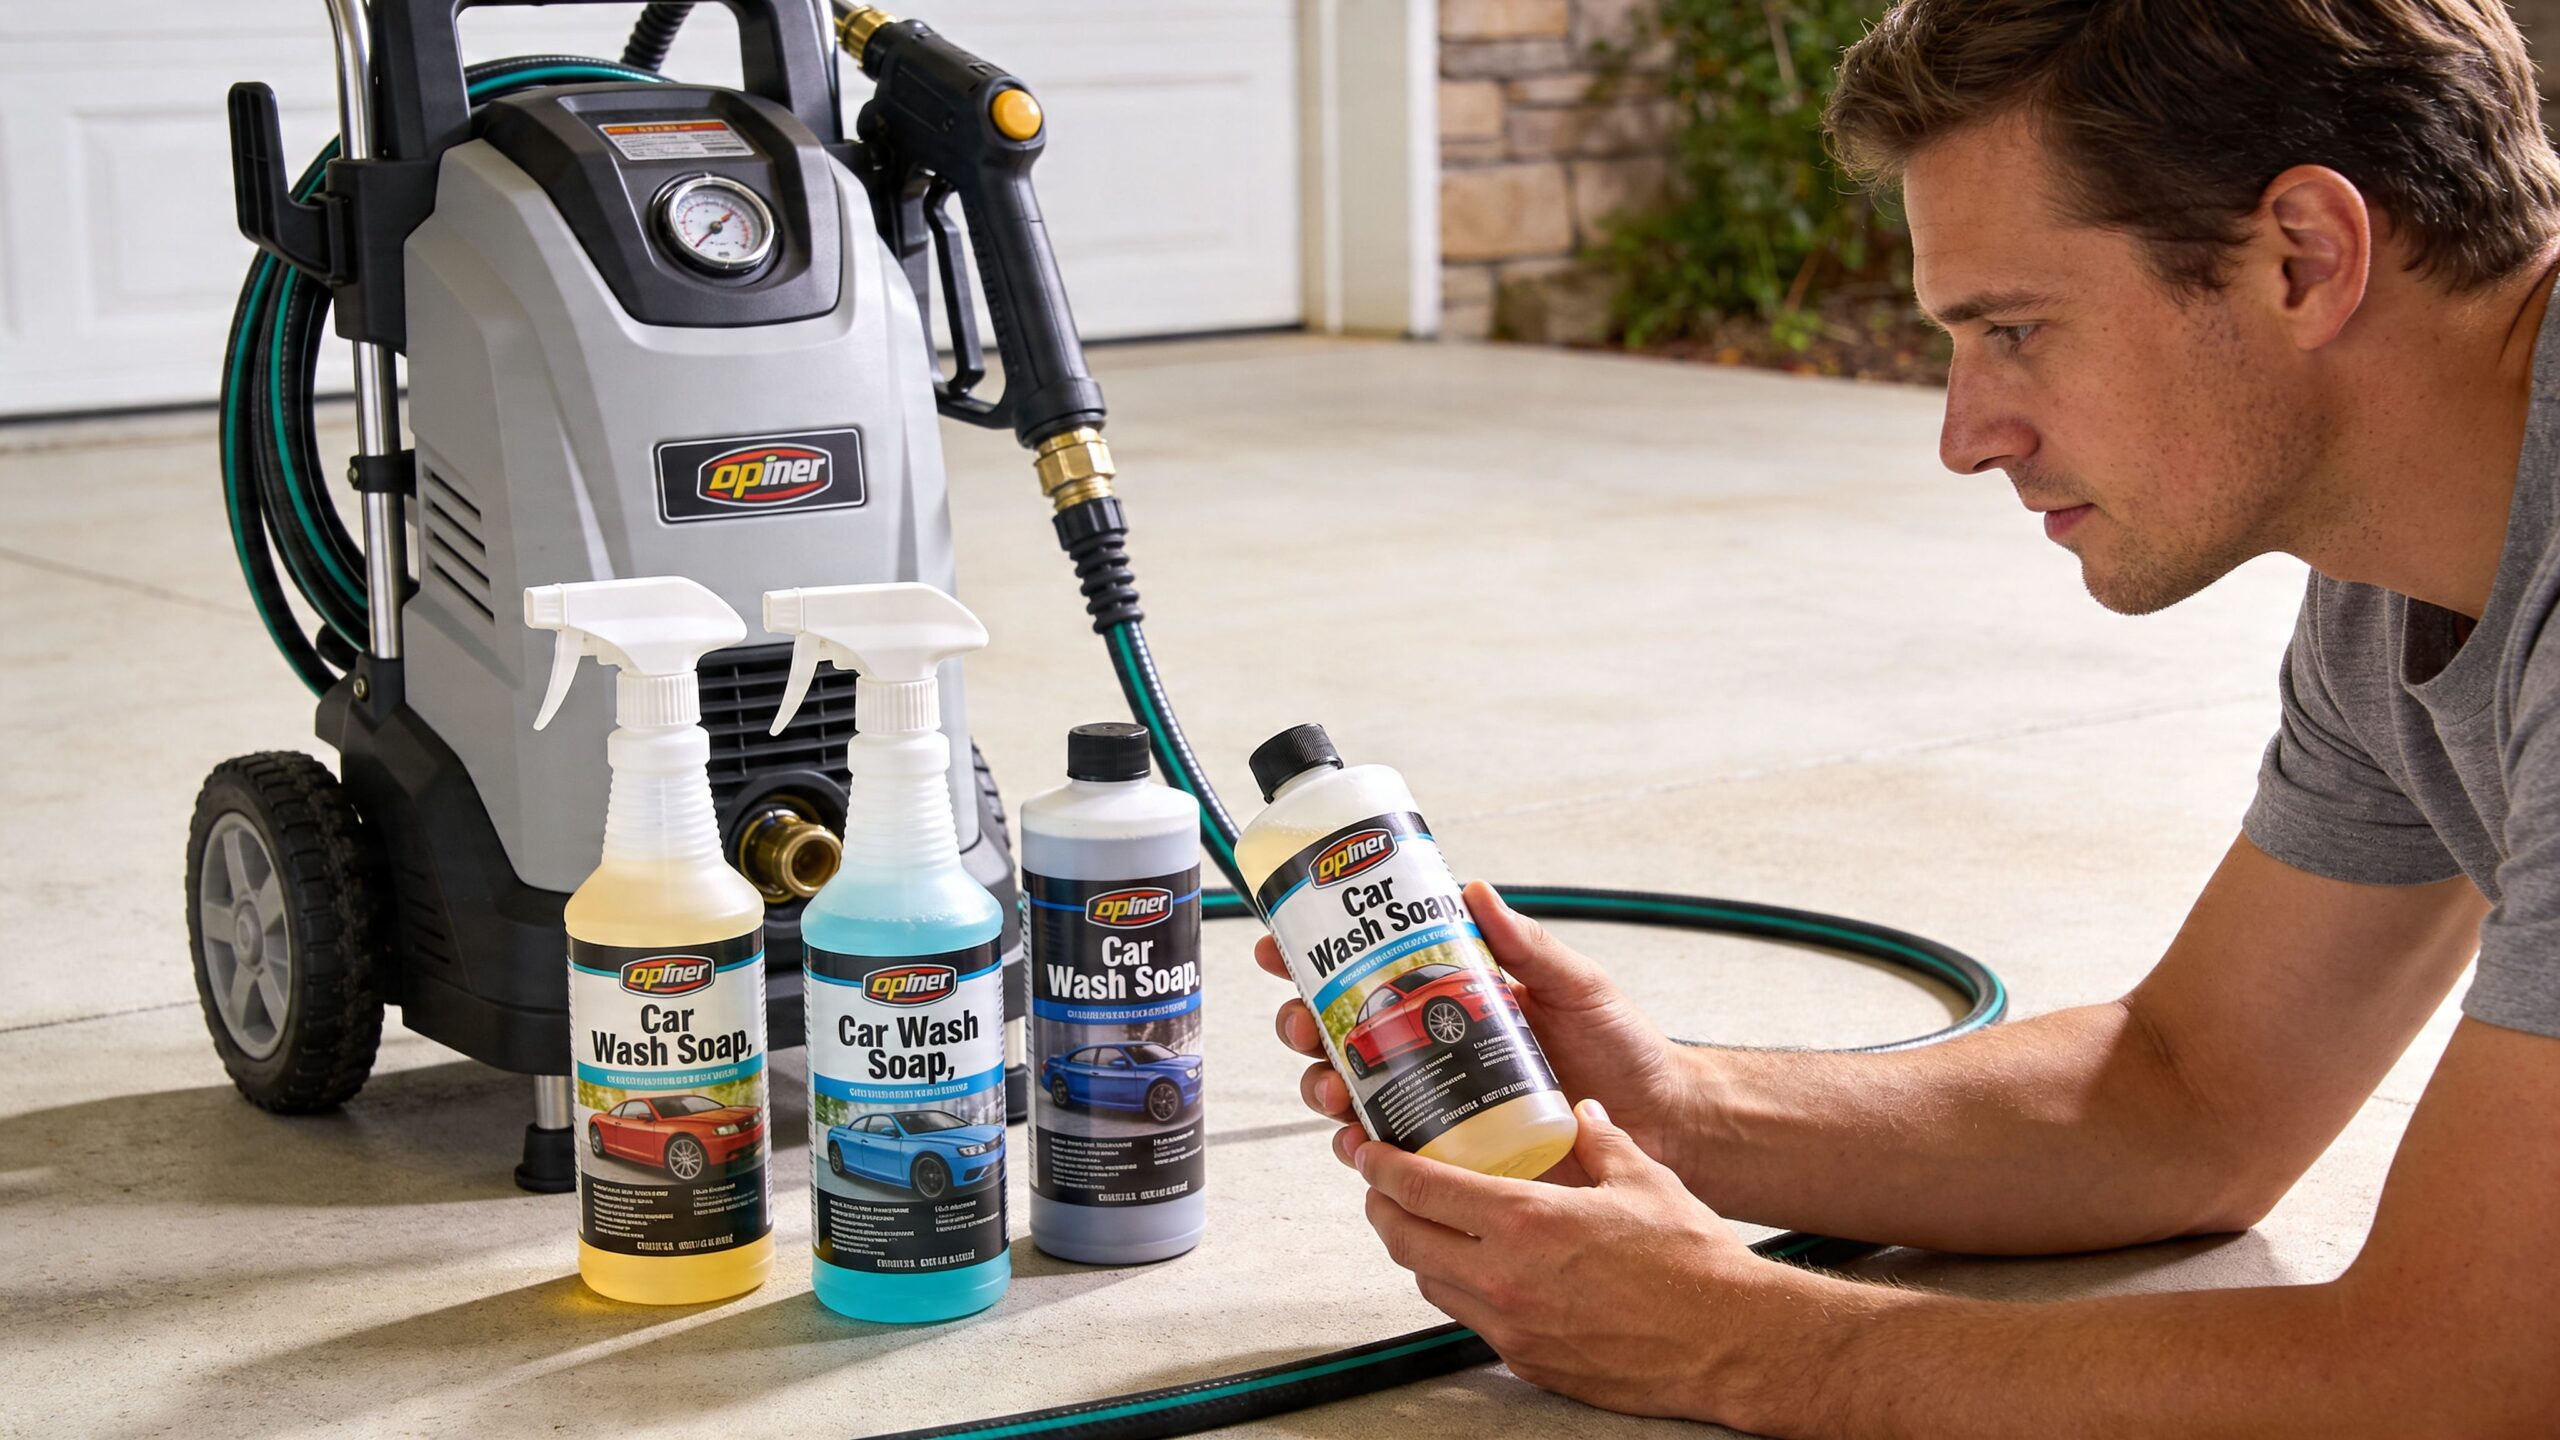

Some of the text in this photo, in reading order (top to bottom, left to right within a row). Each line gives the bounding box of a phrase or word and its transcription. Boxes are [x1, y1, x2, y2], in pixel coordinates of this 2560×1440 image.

[709, 455, 826, 499] opiner
[1341, 876, 1394, 917] Car
[1101, 935, 1154, 967] Car
[1307, 917, 1386, 979] Wash
[1385, 894, 1464, 932] Soap,
[1046, 963, 1127, 1000] Wash
[640, 1003, 695, 1035] Car
[838, 1010, 979, 1049] Car Wash
[591, 1029, 753, 1067] Wash Soap,
[867, 1049, 955, 1085] Soap,
